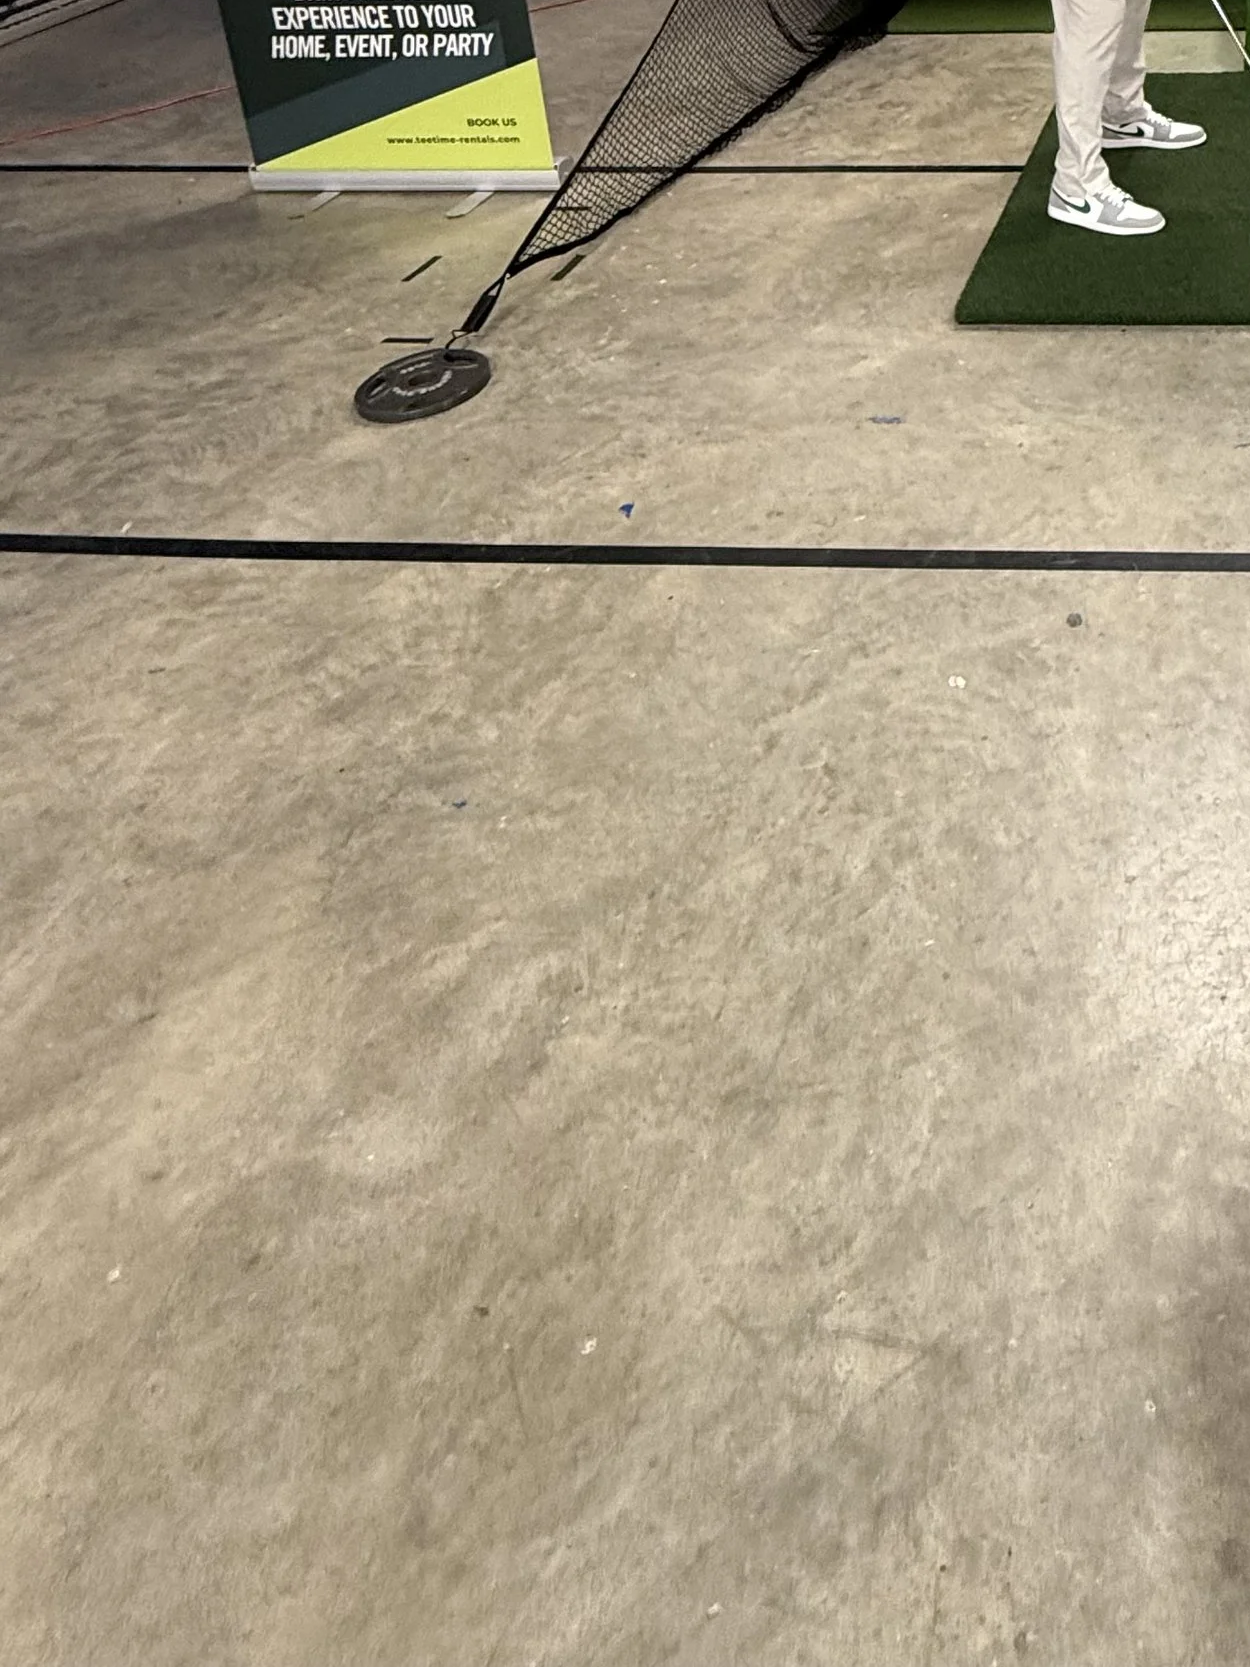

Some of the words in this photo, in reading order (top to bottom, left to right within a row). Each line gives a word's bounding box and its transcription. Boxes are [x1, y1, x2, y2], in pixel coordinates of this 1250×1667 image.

[272, 7, 392, 29] EXPERIENCE
[393, 6, 420, 28] TO
[421, 5, 476, 27] YOUR
[271, 36, 330, 60] HOME,
[335, 35, 397, 60] EVENT,
[402, 34, 428, 56] OR
[432, 33, 494, 57] PARTY
[467, 118, 499, 126] BOOK
[502, 118, 516, 126] US
[387, 135, 520, 145] www.teetime-rentals.com
